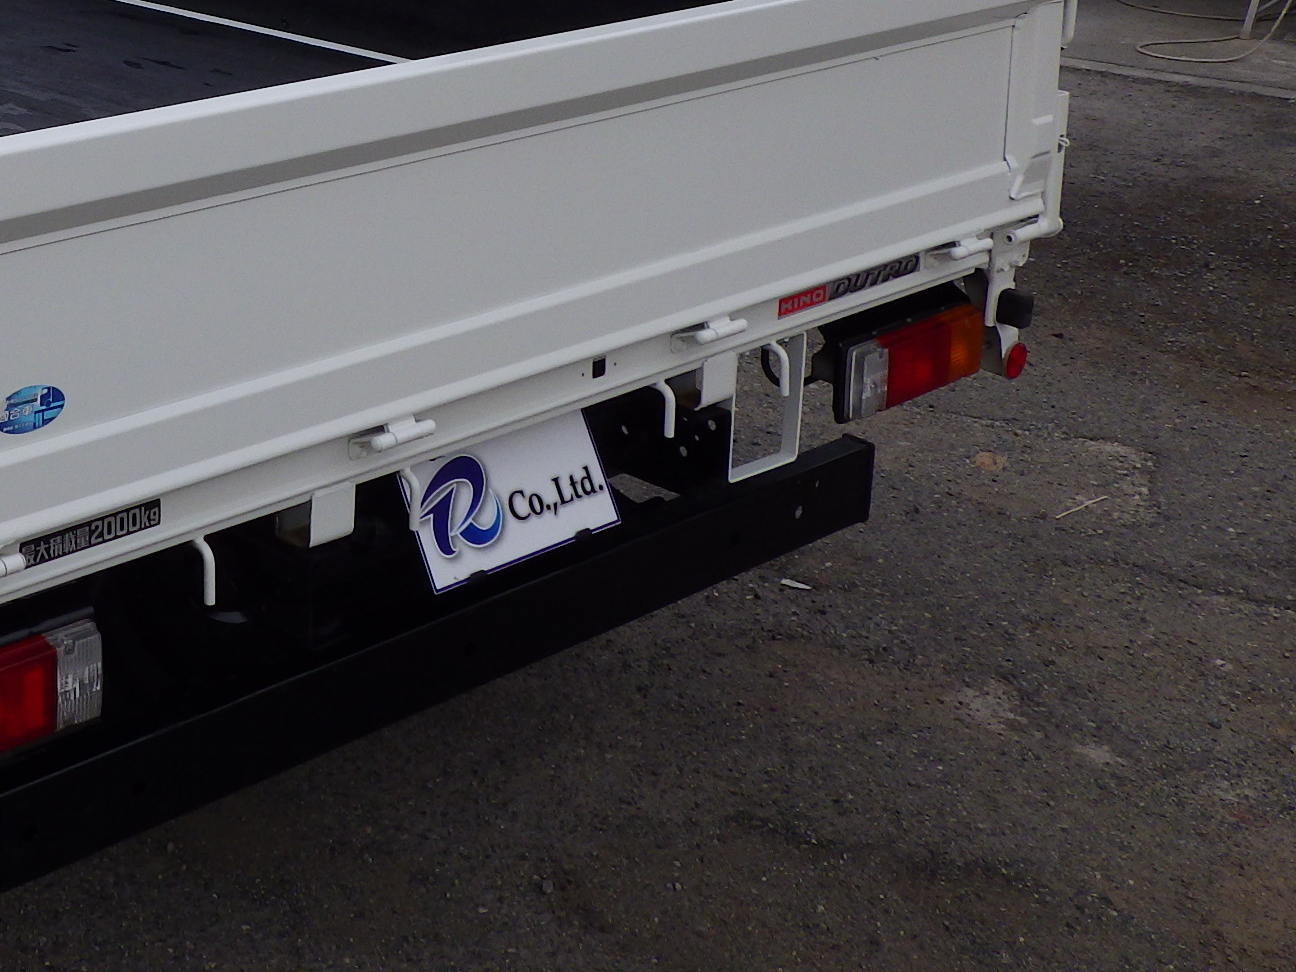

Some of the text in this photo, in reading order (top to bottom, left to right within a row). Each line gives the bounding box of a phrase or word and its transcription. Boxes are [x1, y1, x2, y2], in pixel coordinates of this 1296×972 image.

[780, 254, 920, 312] HINO DUTRO
[507, 465, 605, 521] Co.,Ltd.
